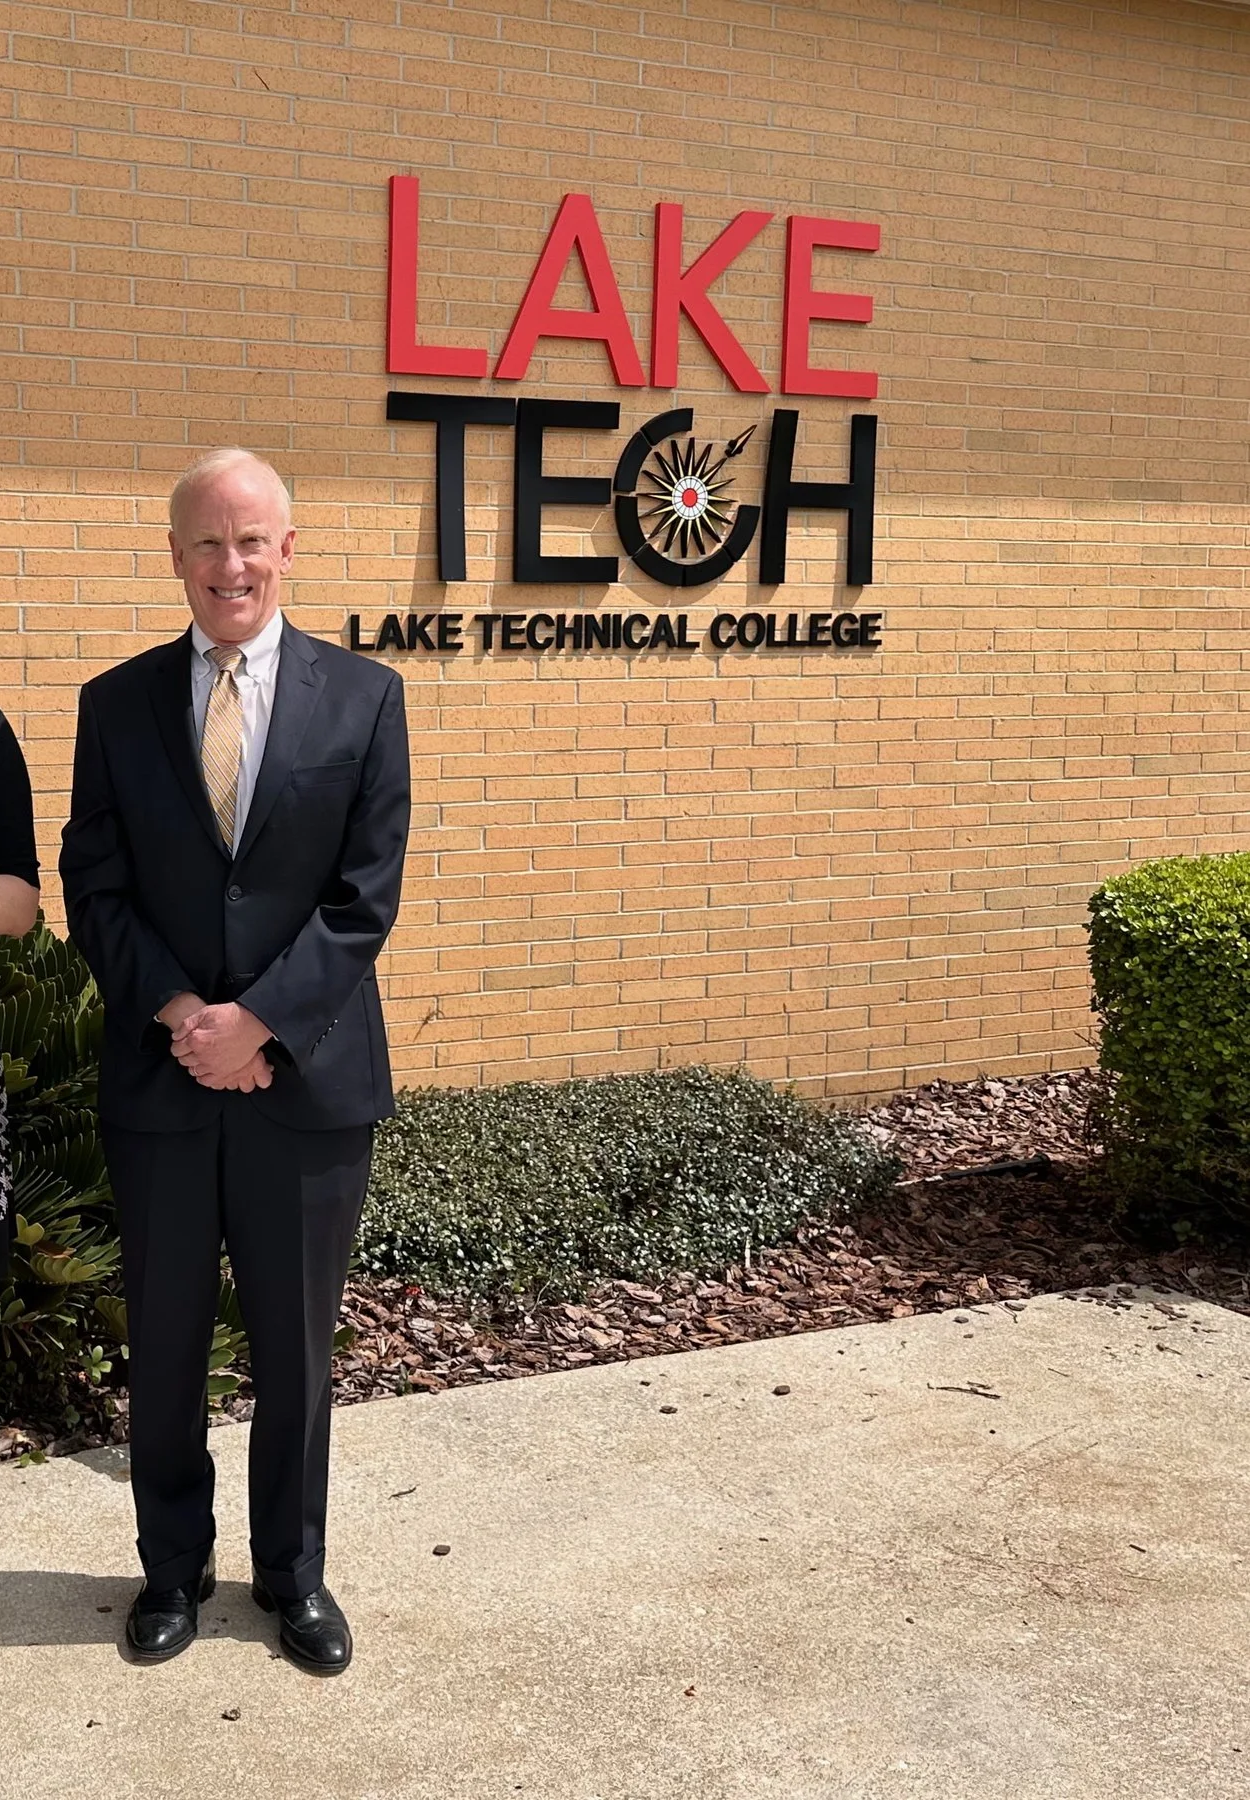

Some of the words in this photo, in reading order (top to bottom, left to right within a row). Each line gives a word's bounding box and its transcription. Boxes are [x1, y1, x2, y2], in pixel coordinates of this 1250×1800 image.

[385, 176, 881, 399] LAKE
[386, 391, 878, 586] TECH
[350, 613, 463, 652] LAKE
[475, 612, 700, 650] TECHNICAL
[711, 612, 882, 648] COLLEGE
